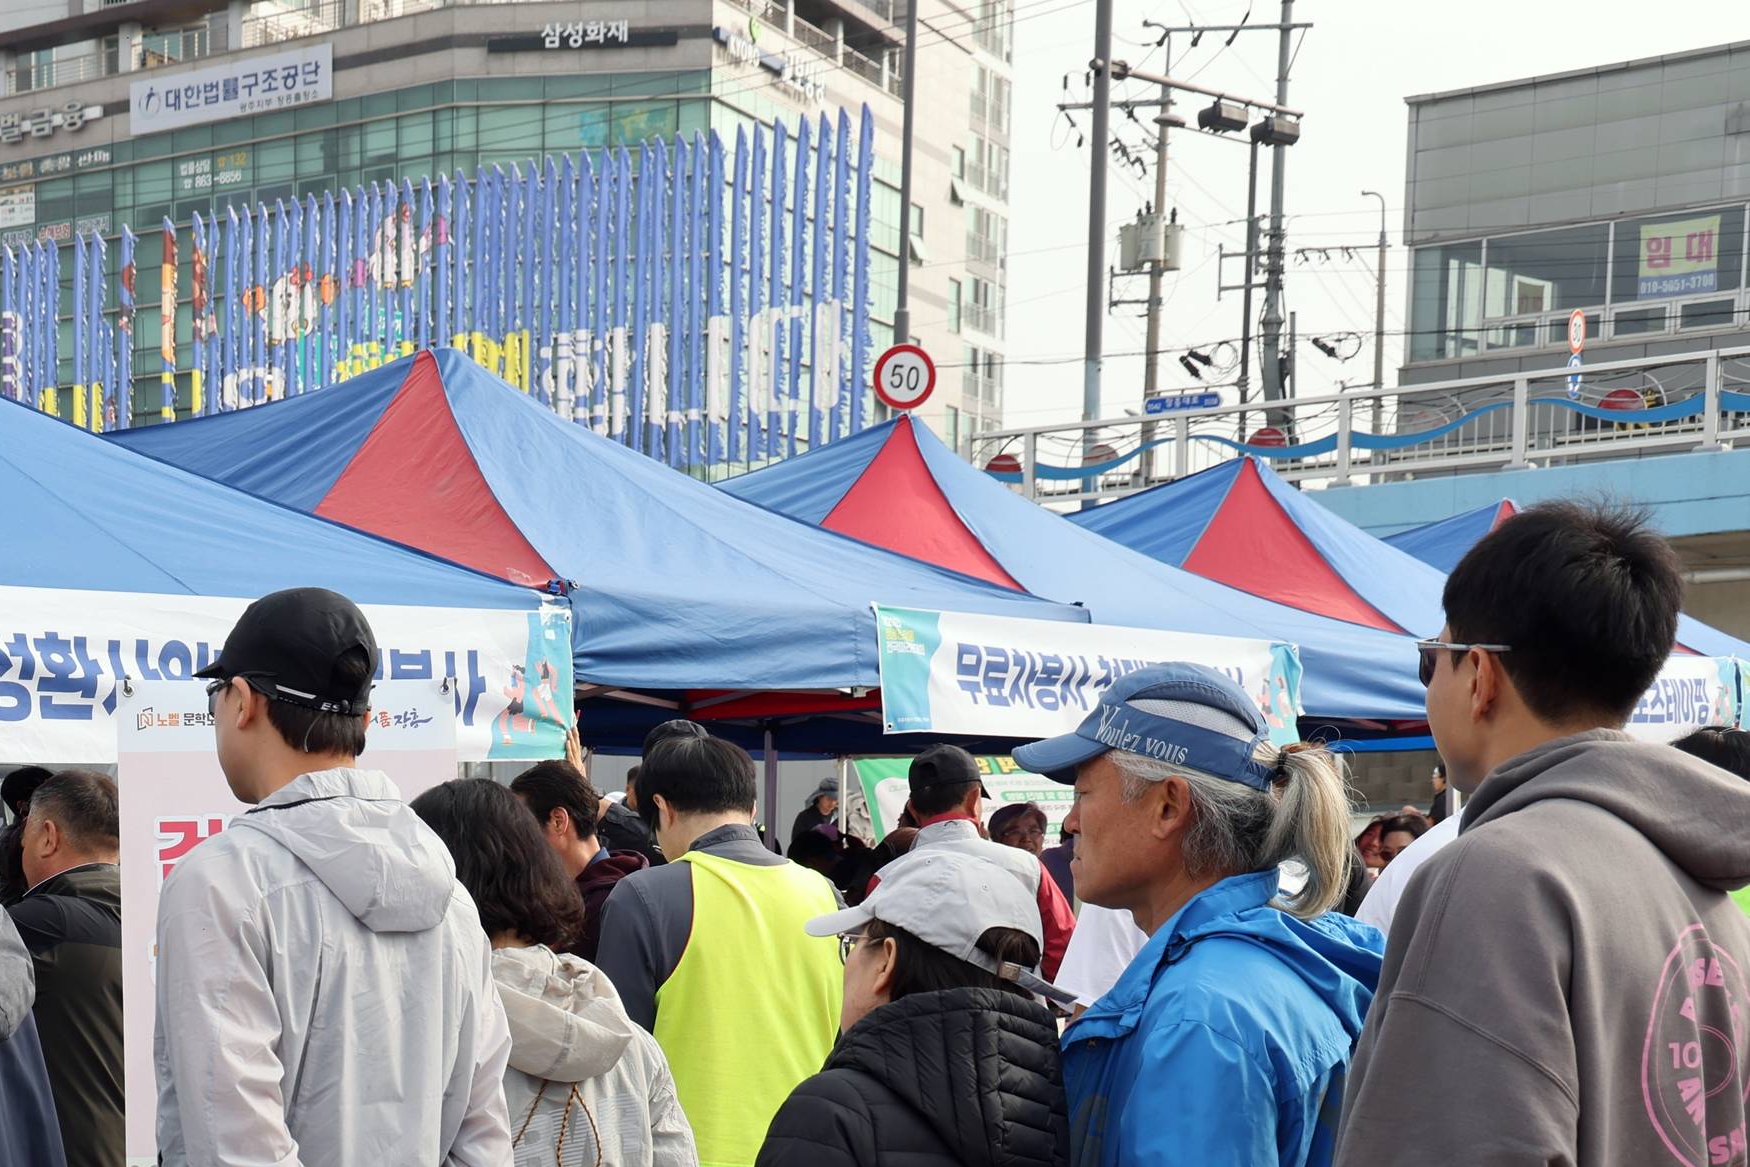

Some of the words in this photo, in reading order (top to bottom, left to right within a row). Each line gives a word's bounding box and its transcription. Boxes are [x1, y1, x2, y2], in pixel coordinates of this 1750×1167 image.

[540, 19, 629, 49] 삼성화재
[164, 60, 321, 112] 대한법률구조공단
[890, 364, 920, 391] 50
[157, 712, 180, 727] 노벨
[1094, 703, 1143, 753] Voulez
[1145, 735, 1189, 766] vous
